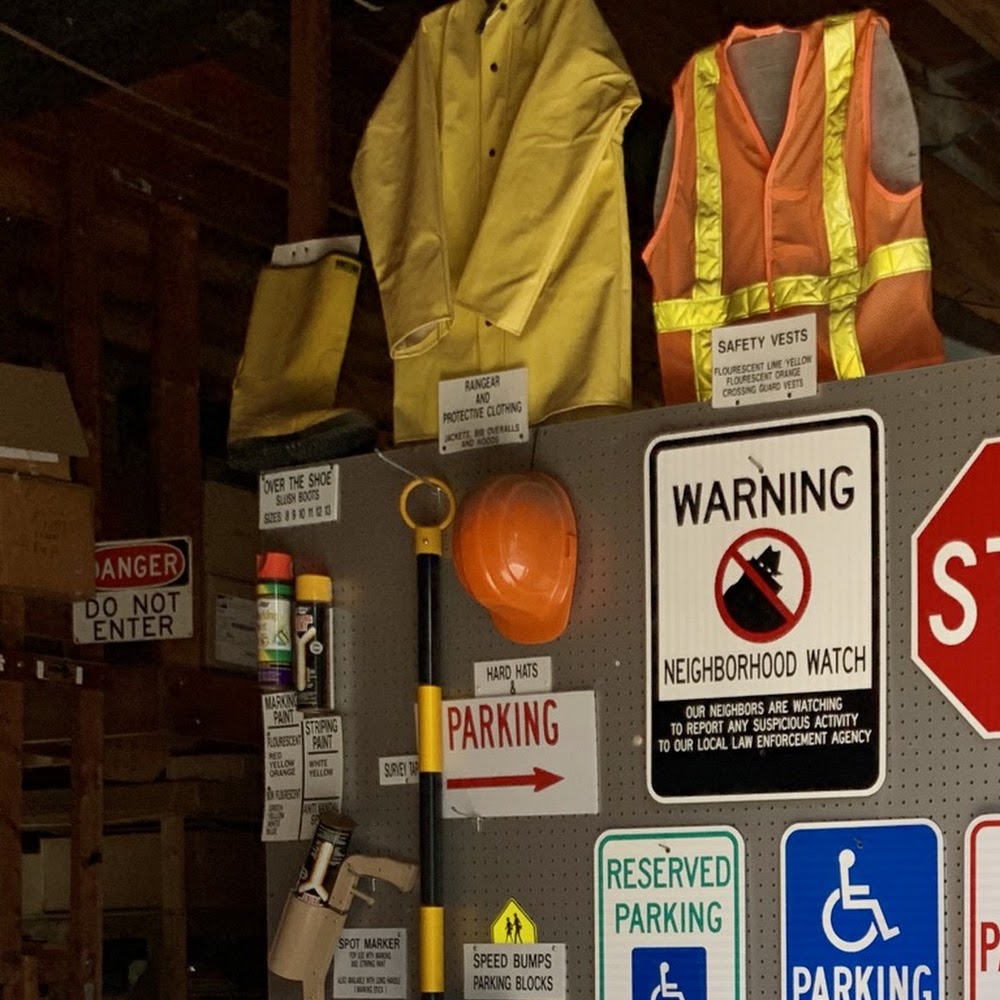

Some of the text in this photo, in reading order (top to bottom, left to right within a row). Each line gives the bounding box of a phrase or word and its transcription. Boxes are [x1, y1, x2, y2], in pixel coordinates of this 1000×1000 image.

[718, 328, 808, 354] SAFETY VESTS
[775, 367, 801, 379] ORANGE
[465, 375, 500, 392] RAINGEAR
[722, 379, 804, 398] CROSSING GUARD VESTS
[476, 391, 490, 404] AND
[443, 401, 522, 424] PROTECTIVE CLOTHING
[264, 471, 332, 494] OVER THE SHOE
[276, 489, 320, 506] SLUSH BOOTS
[673, 464, 855, 528] WARNING
[86, 591, 180, 619] DO NOT
[94, 615, 174, 640] ENTER
[487, 662, 538, 682] HARD HATS
[663, 646, 867, 685] NEIGHBORHOOD WATCH
[509, 680, 516, 695] &
[273, 708, 294, 724] PAINT
[686, 697, 843, 719] OUR NEIGHBORS ARE WATCHING
[305, 718, 338, 735] STRIPING
[447, 699, 559, 751] PARKING
[671, 713, 859, 735] TO REPORT ANY SUSPICIOUS ACTIVITY
[312, 734, 333, 750] PAINT
[659, 729, 872, 753] TO OUR LOCAL LAW ENFORCEMENT AGENCY
[269, 752, 282, 760] RED
[269, 760, 295, 769] YELLOW
[309, 759, 328, 768] WHITE
[269, 768, 296, 777] ORANGE
[309, 768, 334, 777] YELLOW
[384, 760, 418, 778] SURVEY TAP
[607, 855, 731, 890] RESERVED
[615, 900, 722, 934] PARKING
[338, 938, 400, 950] SPOT MARKER
[473, 953, 552, 969] SPEED BUMPS
[473, 975, 553, 991] PARKING BLOCKS
